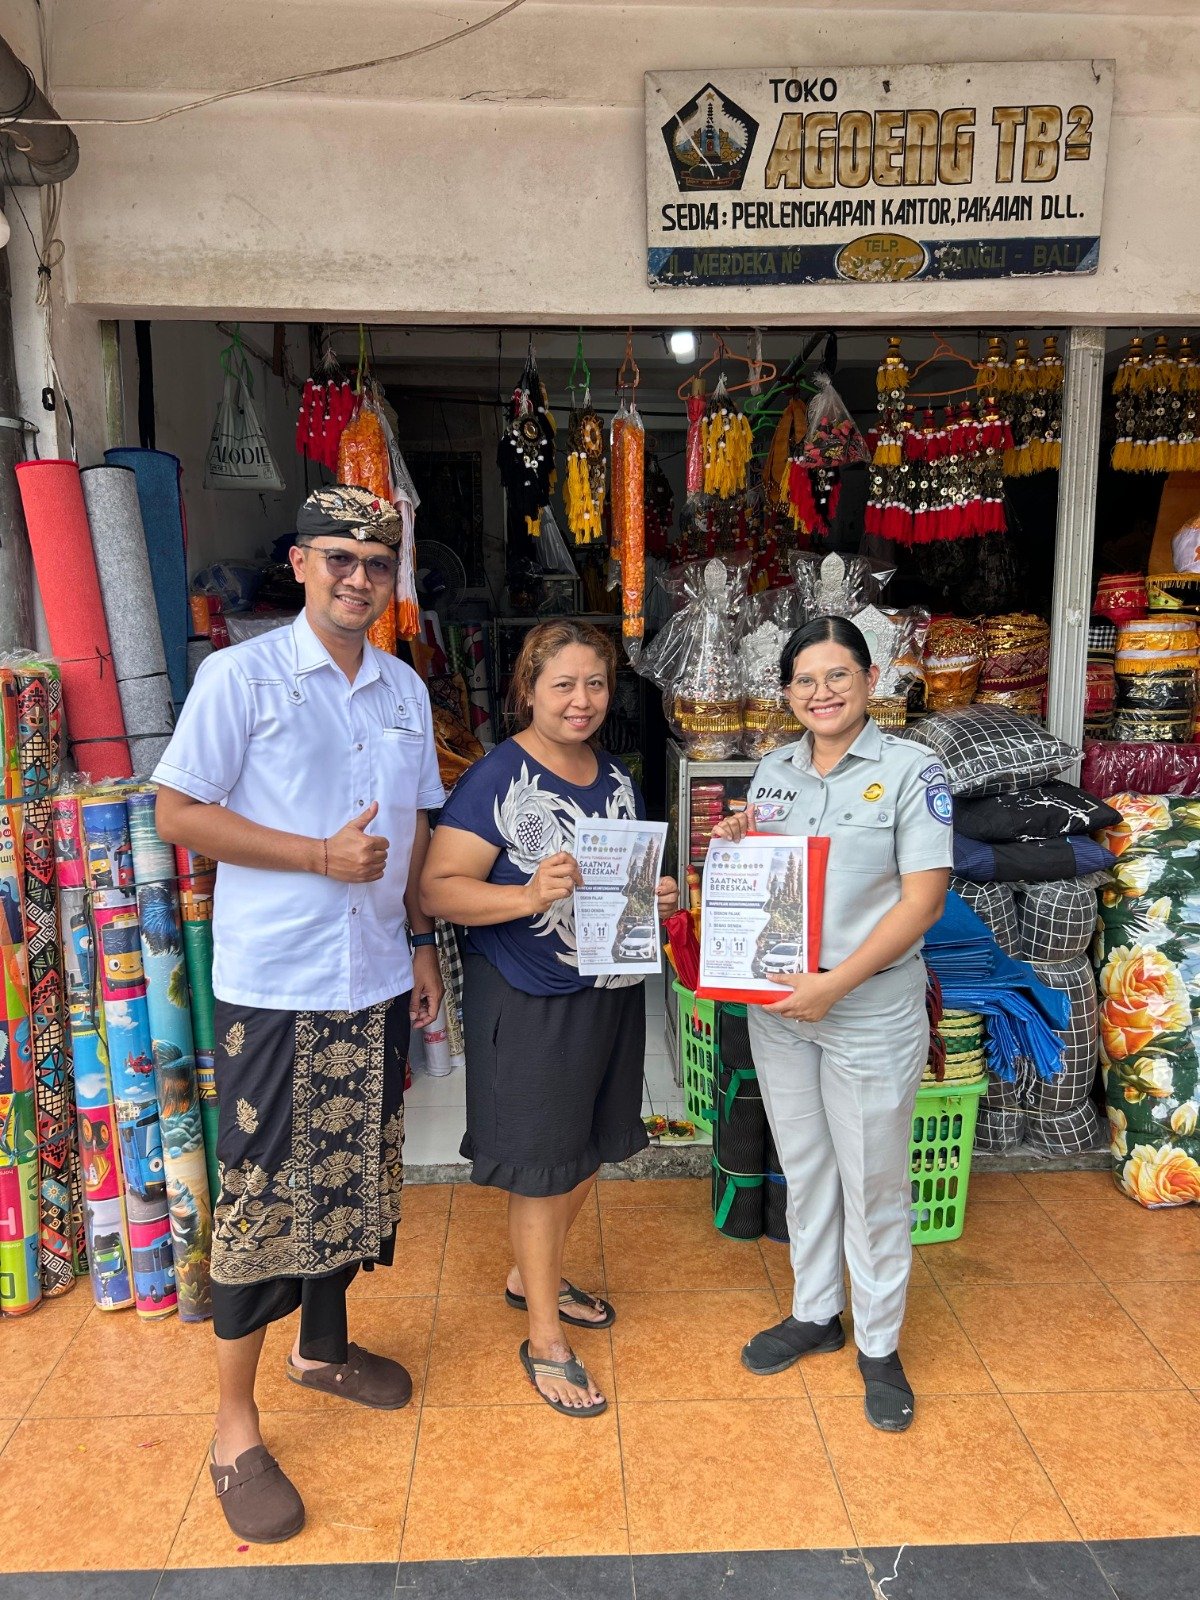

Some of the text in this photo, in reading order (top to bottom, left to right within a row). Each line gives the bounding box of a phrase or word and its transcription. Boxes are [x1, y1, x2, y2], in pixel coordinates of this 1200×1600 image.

[769, 77, 837, 103] TOKO
[764, 107, 976, 189] AGOENG
[732, 199, 875, 229] PERLENGKAPAN
[1041, 194, 1084, 220] DLL.
[693, 252, 776, 276] MERDEKA
[1033, 244, 1081, 267] BALI
[756, 788, 797, 801] DIAN
[583, 926, 605, 937] 9 11
[715, 940, 743, 951] 9 11
